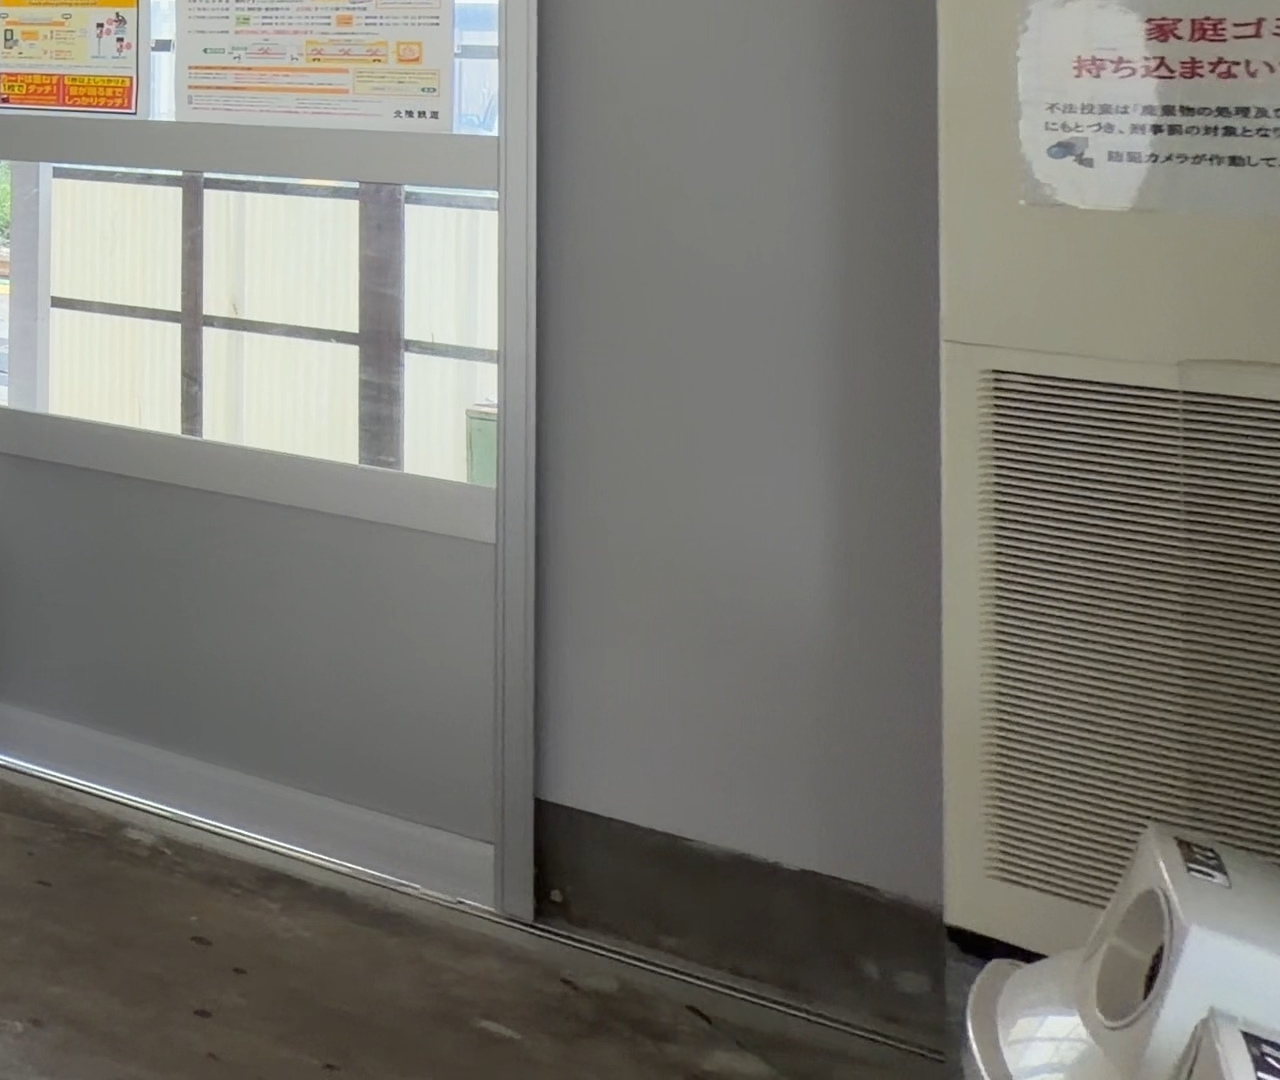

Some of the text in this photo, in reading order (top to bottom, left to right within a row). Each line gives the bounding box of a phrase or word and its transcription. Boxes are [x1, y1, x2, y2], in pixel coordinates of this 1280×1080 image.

[2, 83, 24, 93] 1枚で
[393, 110, 440, 120] 北陸鉄道
[1108, 151, 1280, 168] 防犯カメラが作動して
